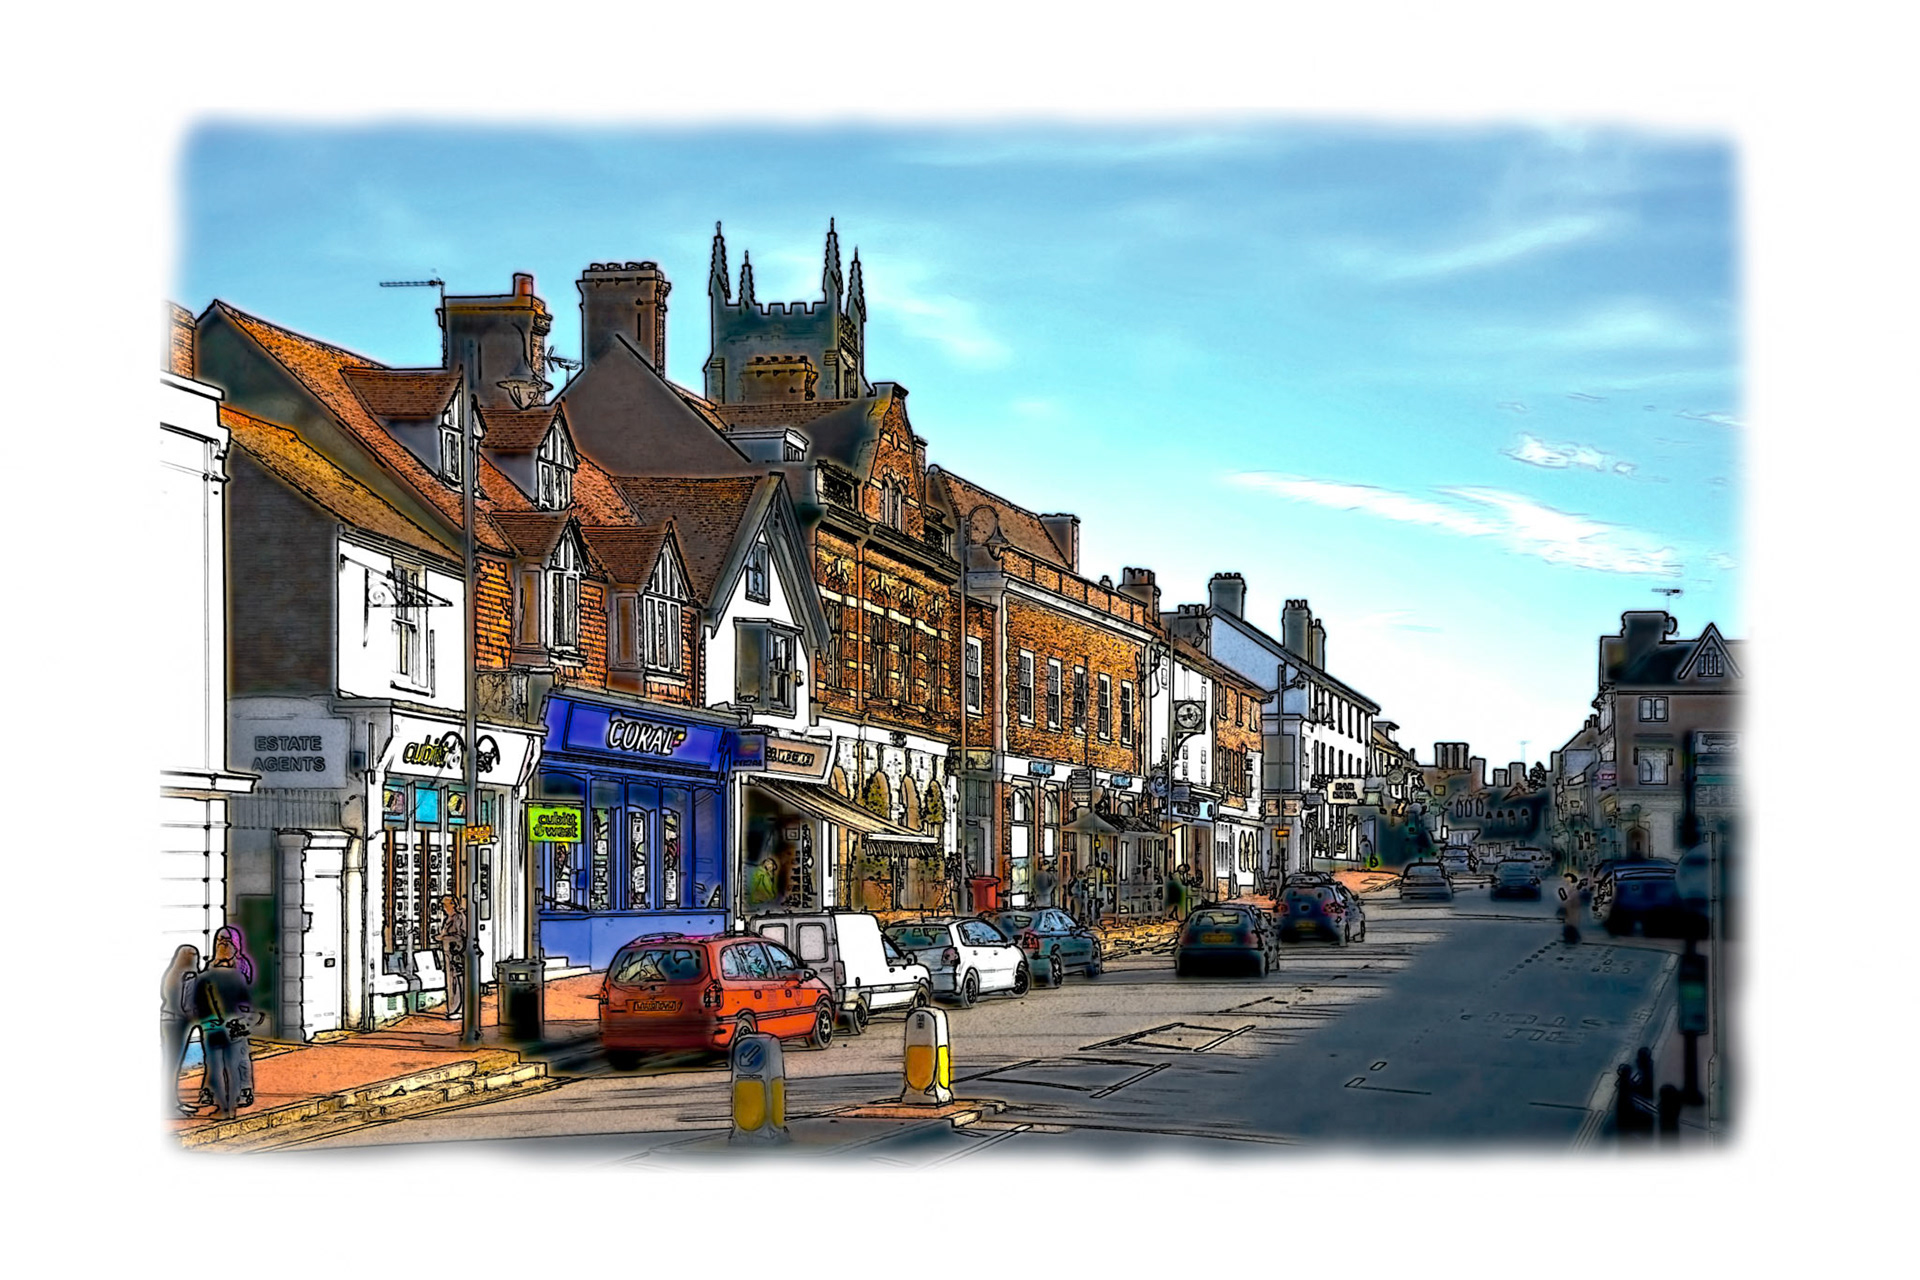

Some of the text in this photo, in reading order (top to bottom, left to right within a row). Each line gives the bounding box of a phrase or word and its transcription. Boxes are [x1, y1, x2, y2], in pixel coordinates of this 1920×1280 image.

[254, 735, 322, 752] ESTATE
[607, 719, 673, 756] CORAL
[251, 756, 326, 773] AGENTS
[538, 811, 578, 826] cubitt
[545, 826, 578, 838] west
